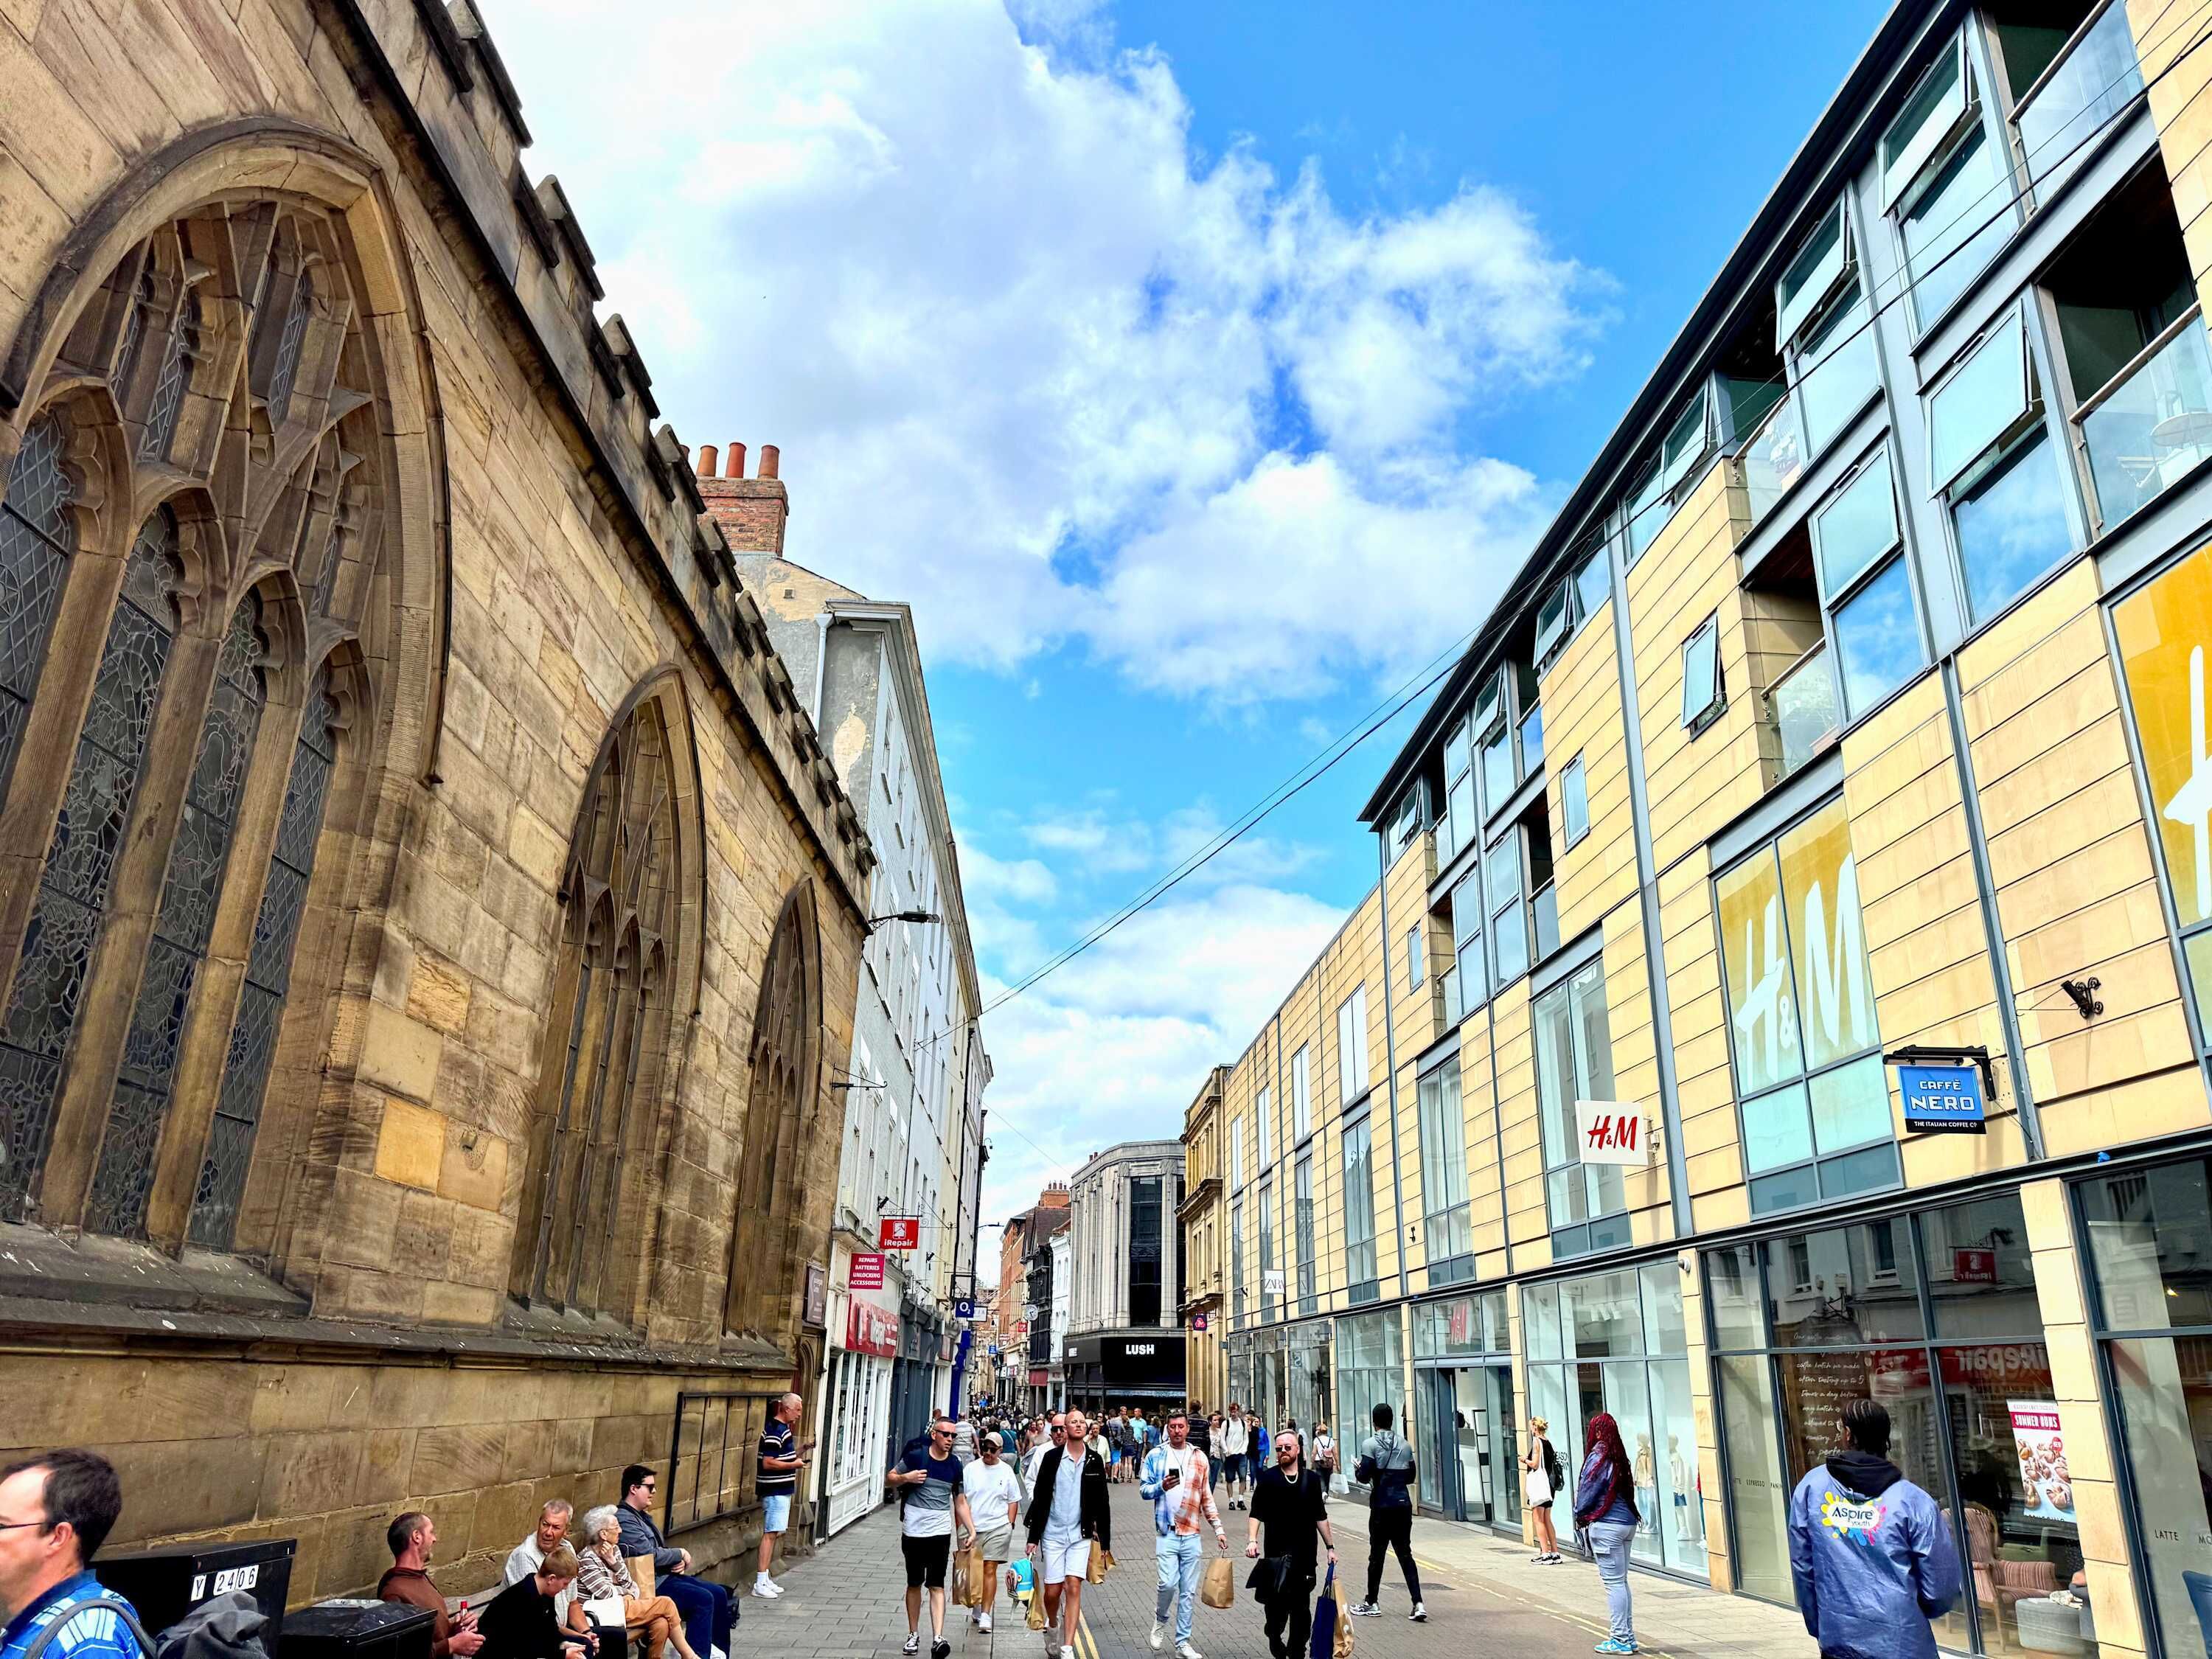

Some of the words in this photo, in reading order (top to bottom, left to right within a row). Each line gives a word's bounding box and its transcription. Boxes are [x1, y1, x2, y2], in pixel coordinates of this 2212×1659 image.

[1735, 851, 1868, 1097] H&M
[1920, 1079, 1961, 1091] CAFFÈ
[1910, 1095, 1975, 1111] NERO
[1587, 1115, 1638, 1152] H&M
[884, 1239, 914, 1248] iRepair
[1125, 1344, 1155, 1355] LUSH
[2014, 1414, 2039, 1427] SUMMER
[2154, 1528, 2180, 1541] LATTE
[195, 1578, 204, 1597] Y
[217, 1568, 255, 1592] 2406
